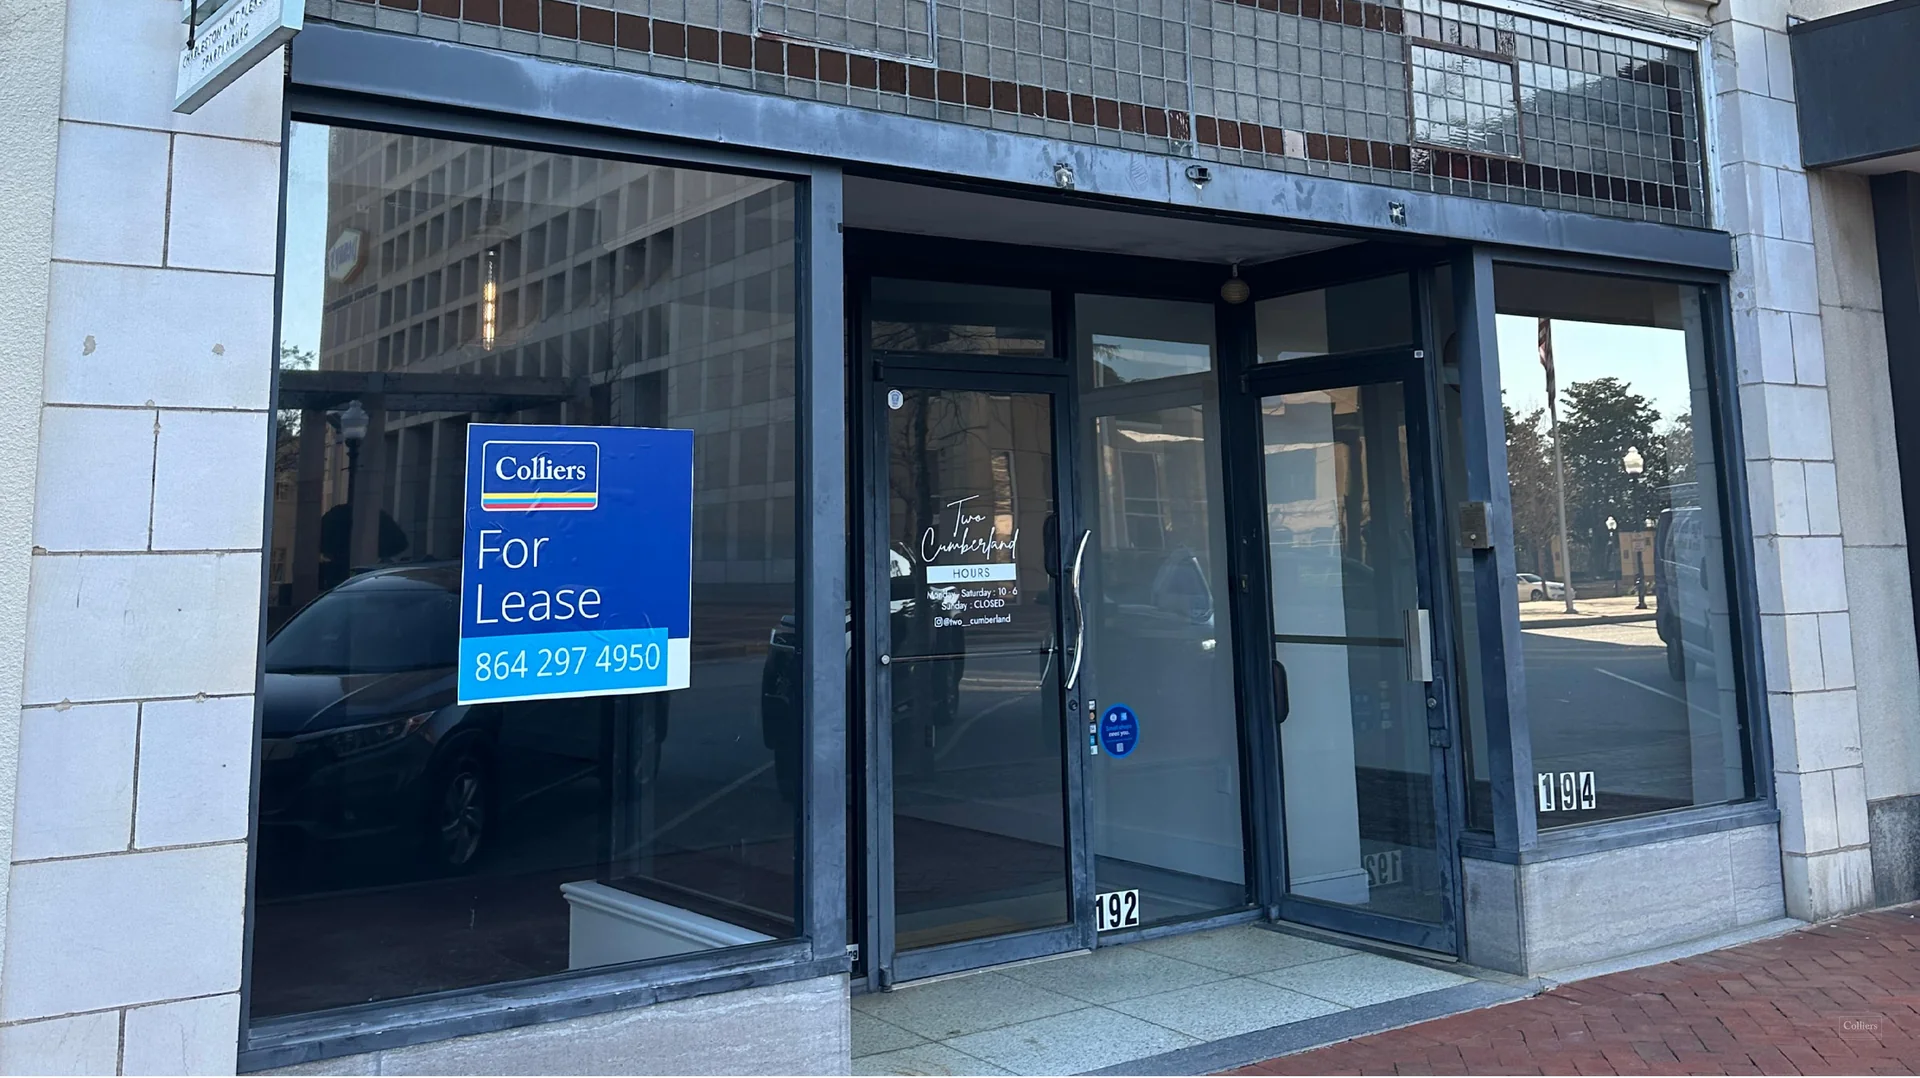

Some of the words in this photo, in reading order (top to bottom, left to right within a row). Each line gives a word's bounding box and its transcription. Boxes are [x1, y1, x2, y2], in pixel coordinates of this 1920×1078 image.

[495, 456, 587, 481] Colliers
[947, 495, 986, 537] Two
[478, 529, 549, 569] For
[921, 526, 1020, 562] Cumberland
[953, 568, 990, 579] HOURS
[961, 587, 992, 598] Saturday
[998, 587, 1007, 595] 10
[1012, 586, 1018, 595] 6
[476, 583, 601, 624] Lease
[941, 600, 968, 611] Sunday
[974, 599, 1005, 609] CLOSED
[475, 650, 528, 681] 864
[537, 646, 587, 677] 297
[595, 643, 660, 673] 4950
[1542, 773, 1594, 810] 194
[1096, 891, 1138, 929] 192
